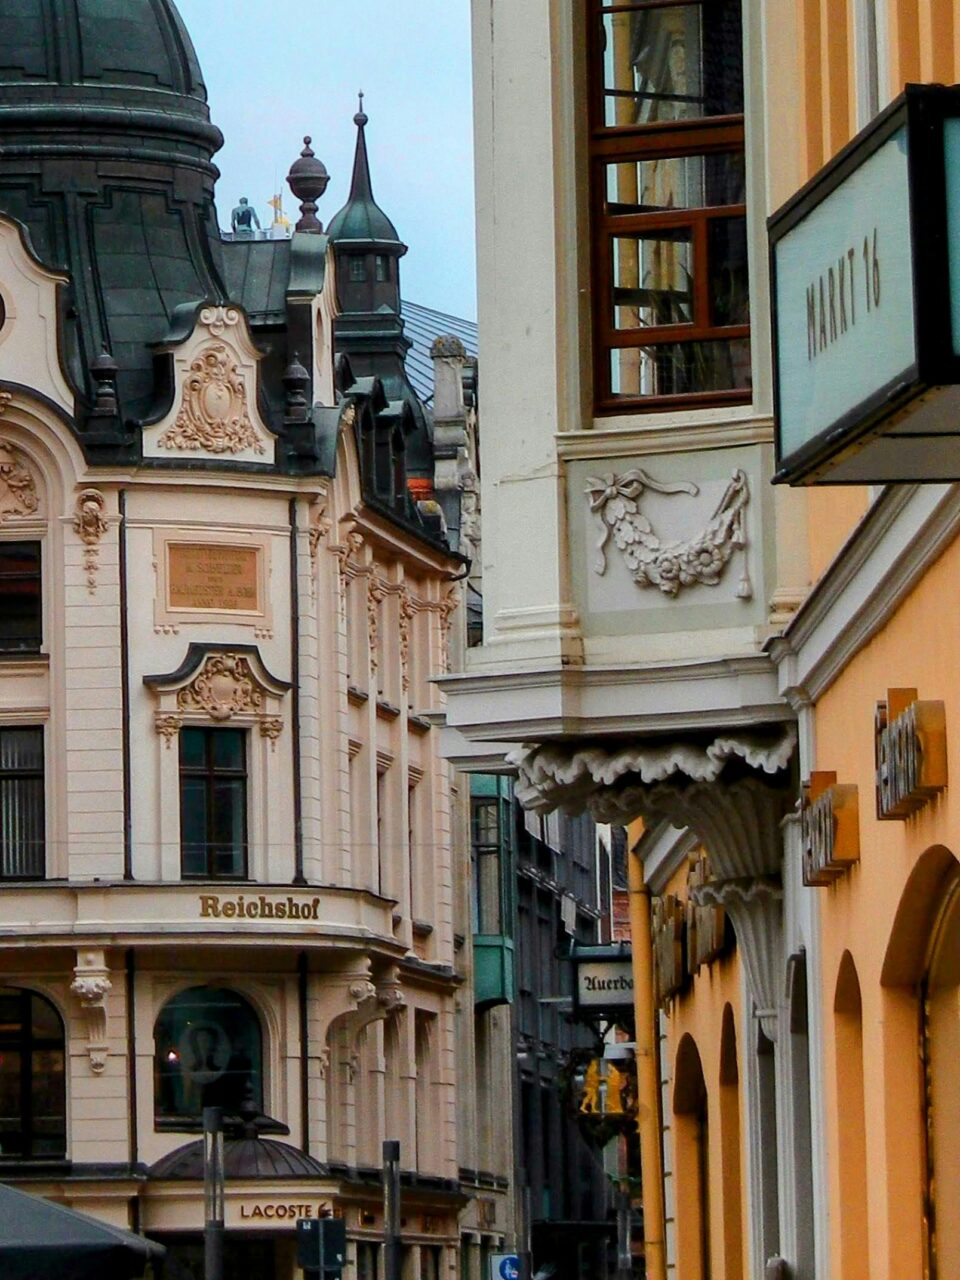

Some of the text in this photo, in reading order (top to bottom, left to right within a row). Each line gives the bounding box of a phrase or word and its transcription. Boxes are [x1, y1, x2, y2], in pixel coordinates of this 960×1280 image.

[806, 227, 880, 361] MARKT 16
[199, 895, 320, 920] Reichshof
[240, 1204, 312, 1219] LACOSTE
